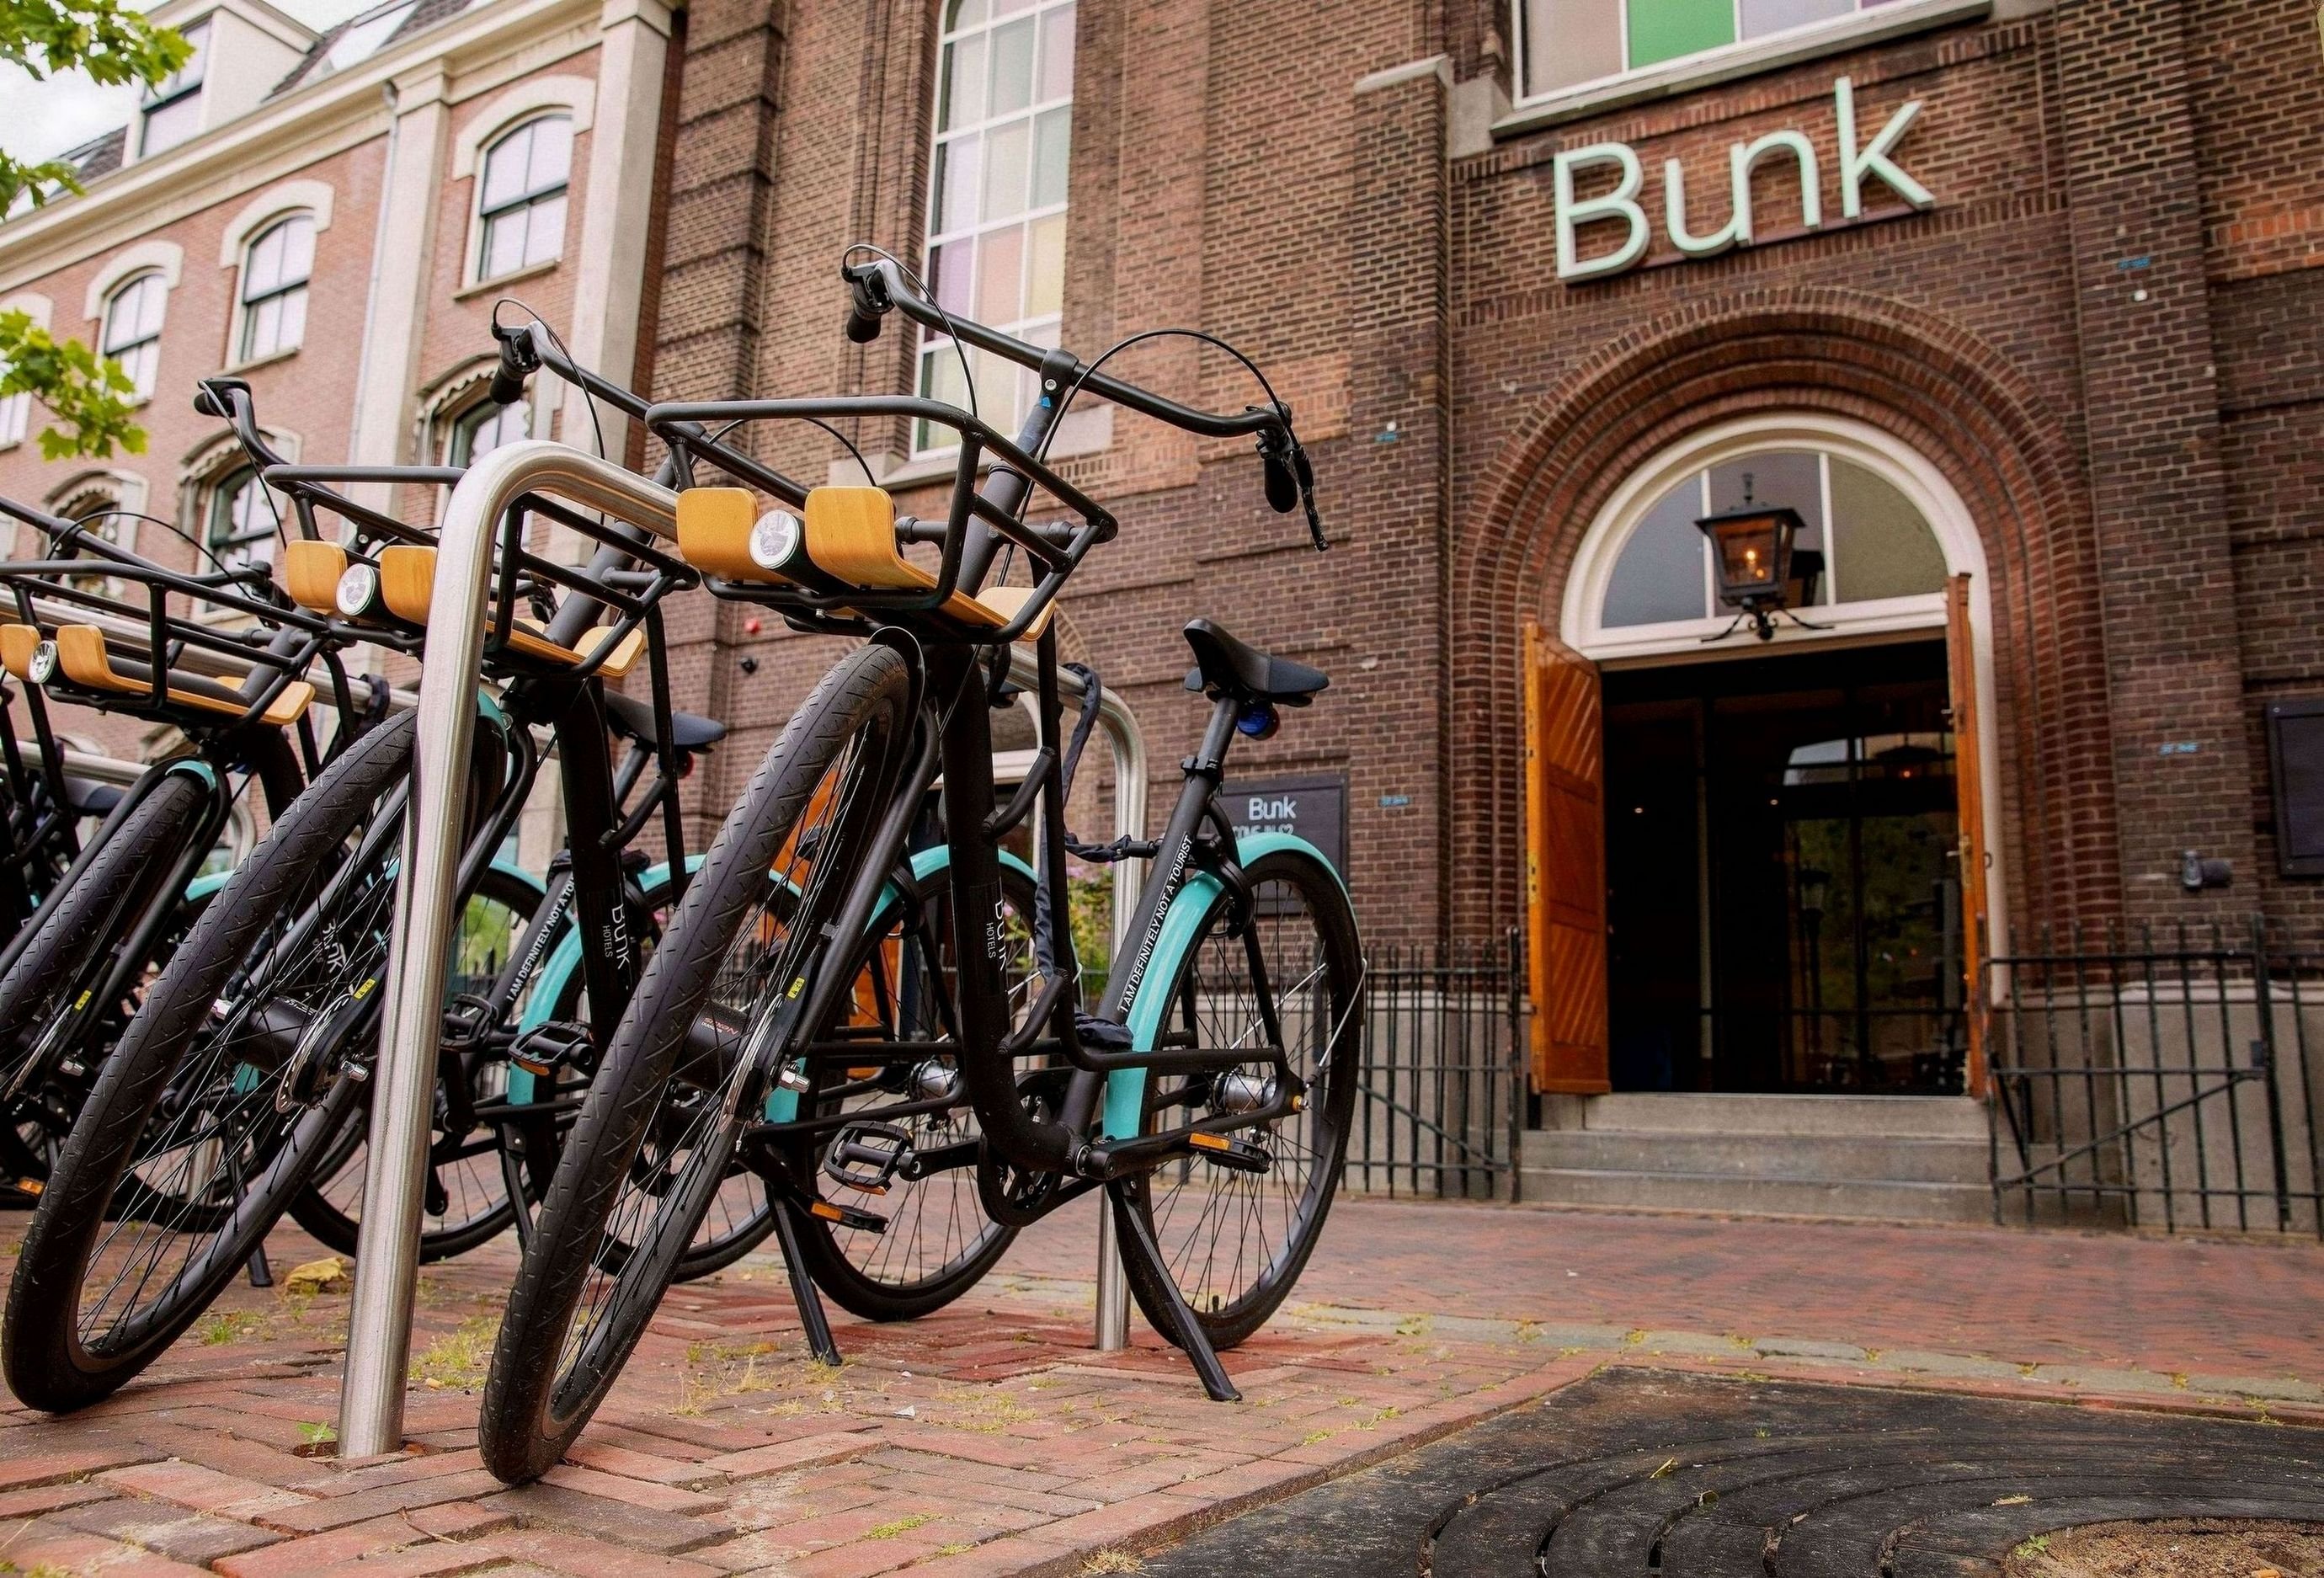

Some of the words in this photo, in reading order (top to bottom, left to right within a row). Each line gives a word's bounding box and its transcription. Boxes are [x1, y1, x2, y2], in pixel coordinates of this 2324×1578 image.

[1554, 76, 1936, 284] Bunk
[1249, 796, 1297, 821] Bunk
[1169, 834, 1193, 882] TOURIST
[1156, 893, 1170, 920] NOT
[1166, 884, 1175, 895] A
[509, 978, 523, 997] AM
[518, 925, 551, 978] DEFINITELY
[546, 904, 562, 927] NOT
[558, 897, 568, 907] A
[602, 925, 613, 958] HOTELS
[611, 904, 631, 970] Bunk
[986, 922, 996, 958] HOTELS
[1131, 918, 1162, 984] DEFINITELY
[1124, 984, 1137, 1006] AM
